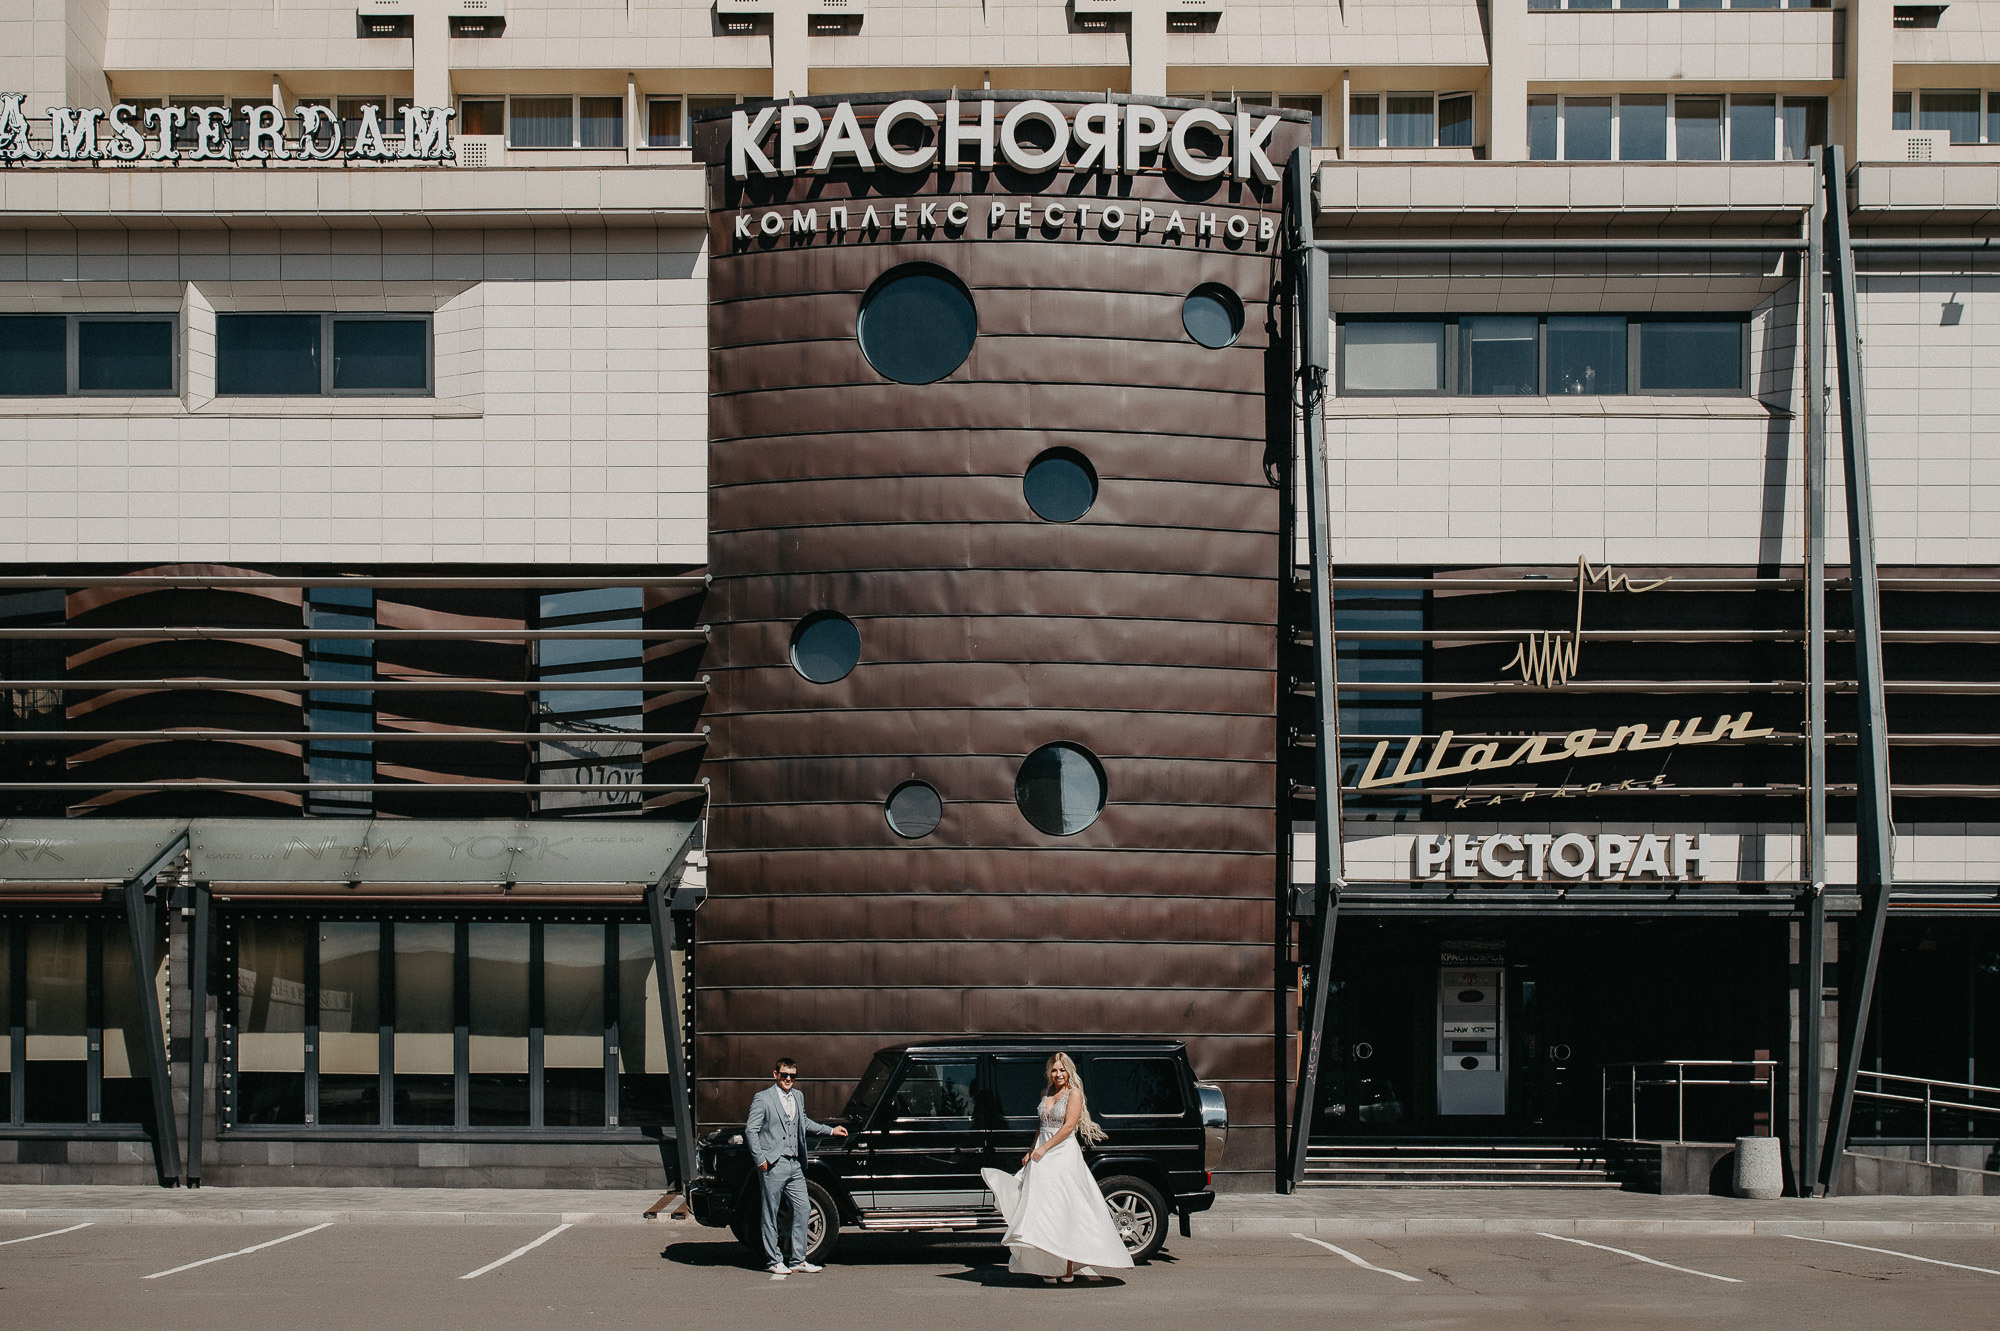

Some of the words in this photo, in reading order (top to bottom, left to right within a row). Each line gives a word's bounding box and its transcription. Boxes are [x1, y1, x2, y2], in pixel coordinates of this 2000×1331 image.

[0, 91, 456, 161] AMSTERDAM
[732, 99, 1281, 186] КРАСНОЯРСК
[735, 201, 969, 239] КОМПЛЕКС
[991, 201, 1274, 242] РЕСТОРАНОВ
[1358, 711, 1774, 789] Шаляпин
[1454, 774, 1667, 809] КАРАОКЕ
[442, 835, 574, 861] YORK
[1416, 834, 1711, 879] РЕСТОРАН
